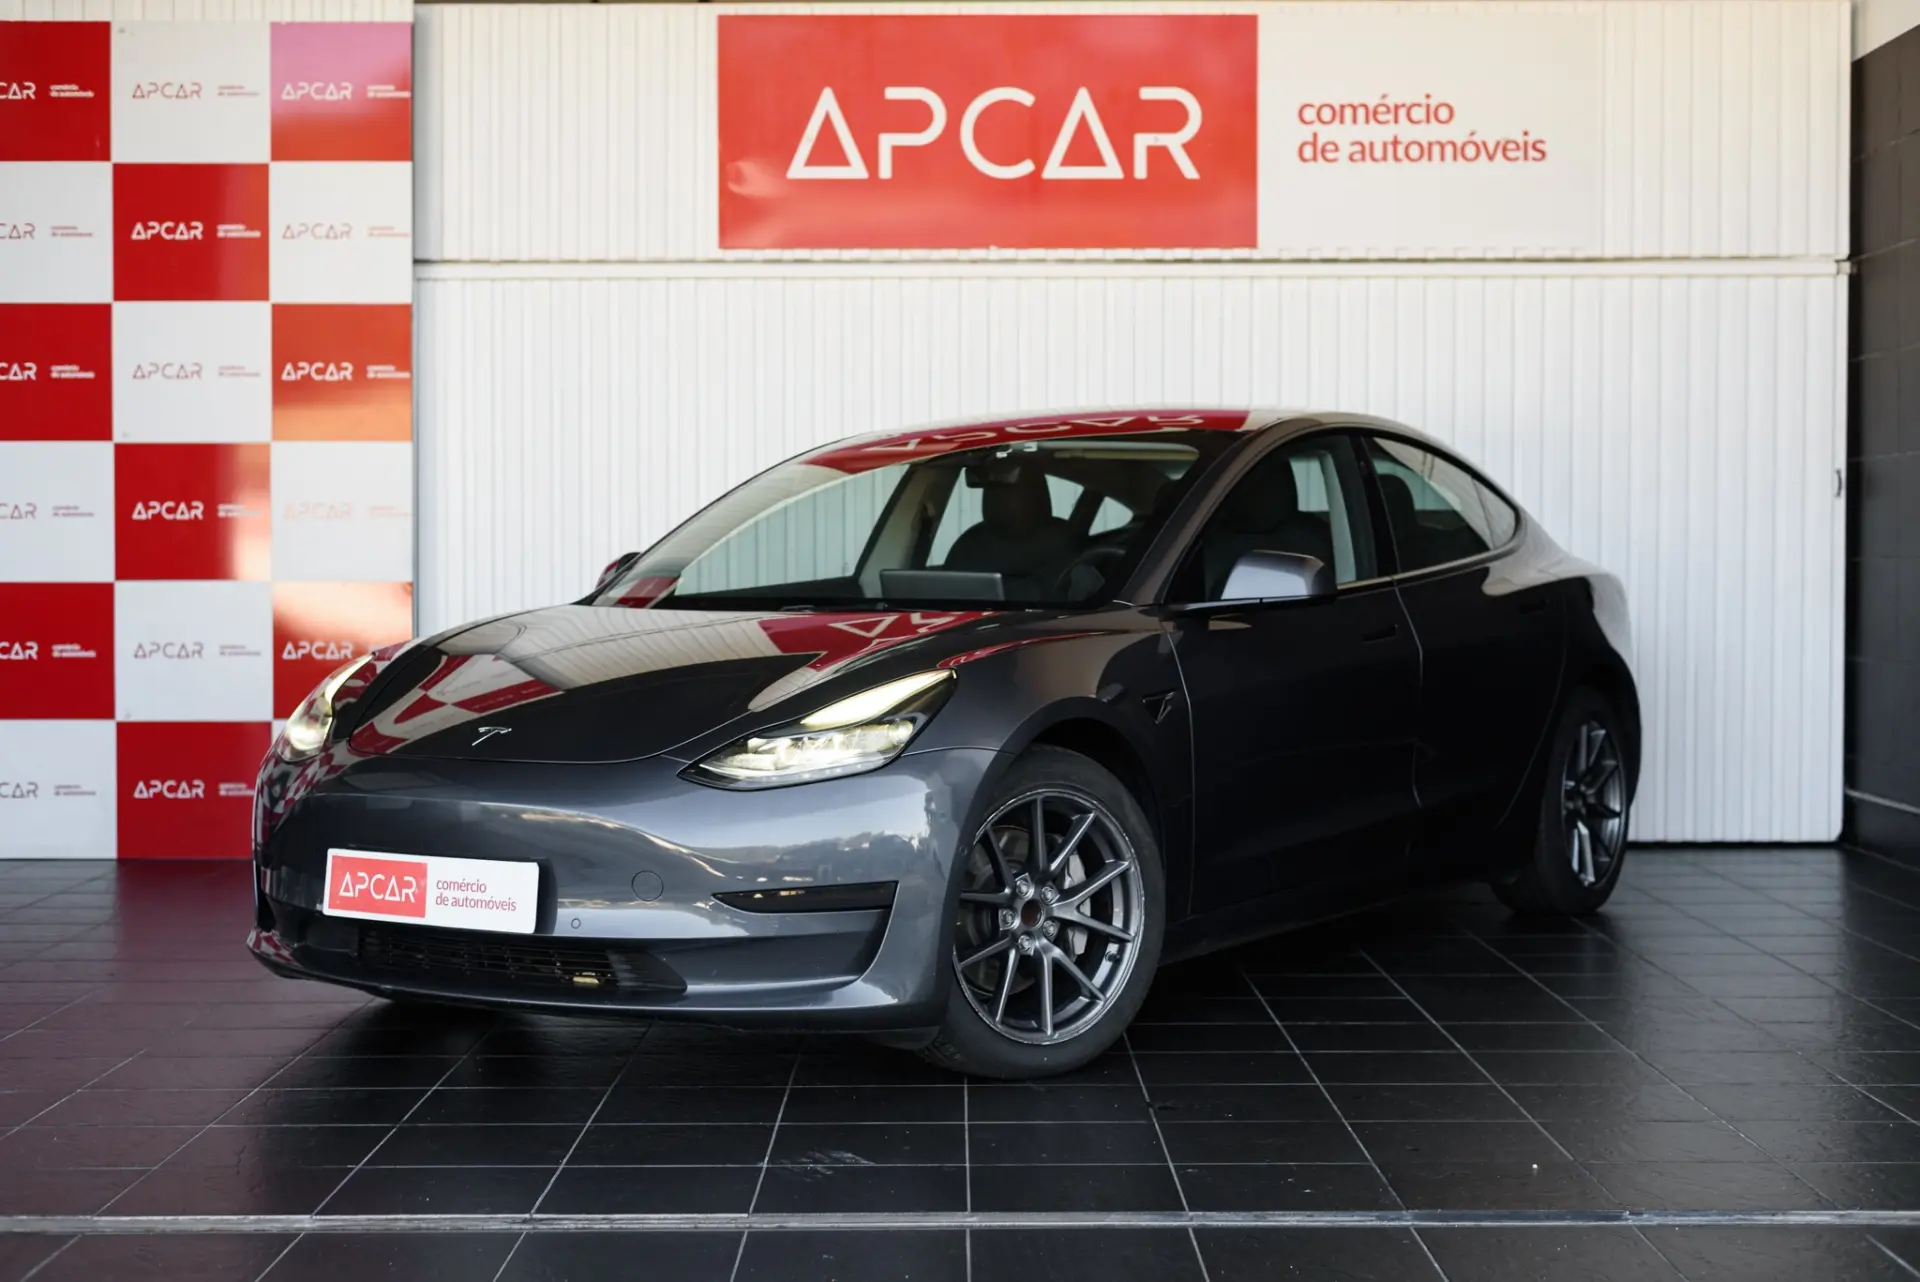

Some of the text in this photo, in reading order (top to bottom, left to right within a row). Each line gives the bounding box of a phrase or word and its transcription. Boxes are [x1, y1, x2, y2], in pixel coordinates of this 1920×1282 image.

[132, 82, 202, 99] APCAR
[281, 82, 353, 100] APCAR
[1298, 94, 1454, 125] comércio
[786, 87, 1203, 180] APCAR
[1298, 131, 1547, 163] de automóveis
[131, 221, 203, 240] APCAR
[282, 223, 353, 240] APCAR
[133, 362, 202, 379] APCAR
[281, 362, 353, 381] APCAR
[132, 501, 204, 520] APCAR
[134, 642, 204, 659] APCAR
[282, 641, 354, 661] APCAR
[134, 780, 204, 798] APCAR
[339, 871, 417, 903] APCAR
[436, 878, 487, 894] comércio
[435, 892, 517, 912] de automóveis
